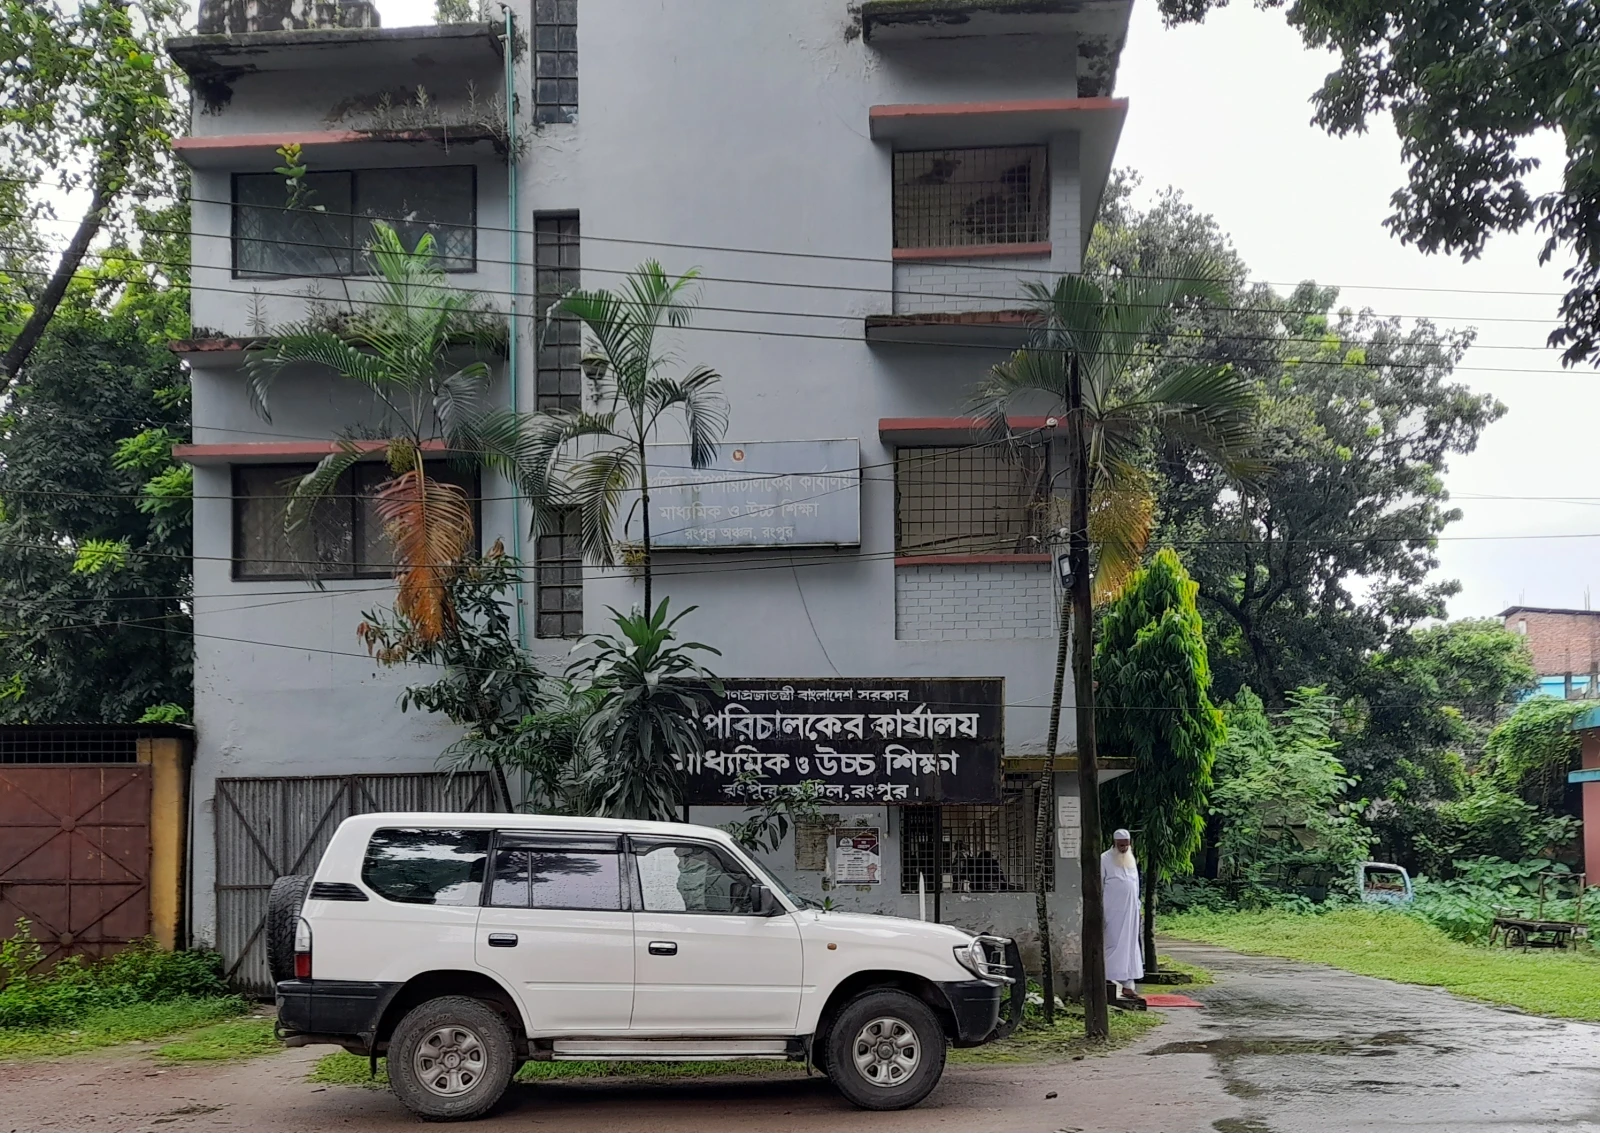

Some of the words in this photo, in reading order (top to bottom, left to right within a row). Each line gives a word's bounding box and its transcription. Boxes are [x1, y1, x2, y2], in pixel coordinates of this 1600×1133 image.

[659, 501, 722, 521] মাধ্যমিক
[727, 505, 740, 517] ও
[744, 500, 777, 518] উচ্চ
[781, 499, 820, 518] শিক্ষা
[684, 527, 717, 542] রংপুর
[720, 527, 758, 541] অঞ্চল,
[761, 525, 795, 541] রংপুর
[797, 688, 853, 702] বাংলাদেশ
[857, 689, 910, 702] সরকার
[672, 702, 866, 742] পরিচালকের
[868, 702, 981, 740] কার্যালয়
[795, 756, 810, 775] ও
[814, 743, 877, 777] উচ্চ
[883, 743, 961, 777] শিক্ষা
[850, 782, 910, 802] রংপুর
